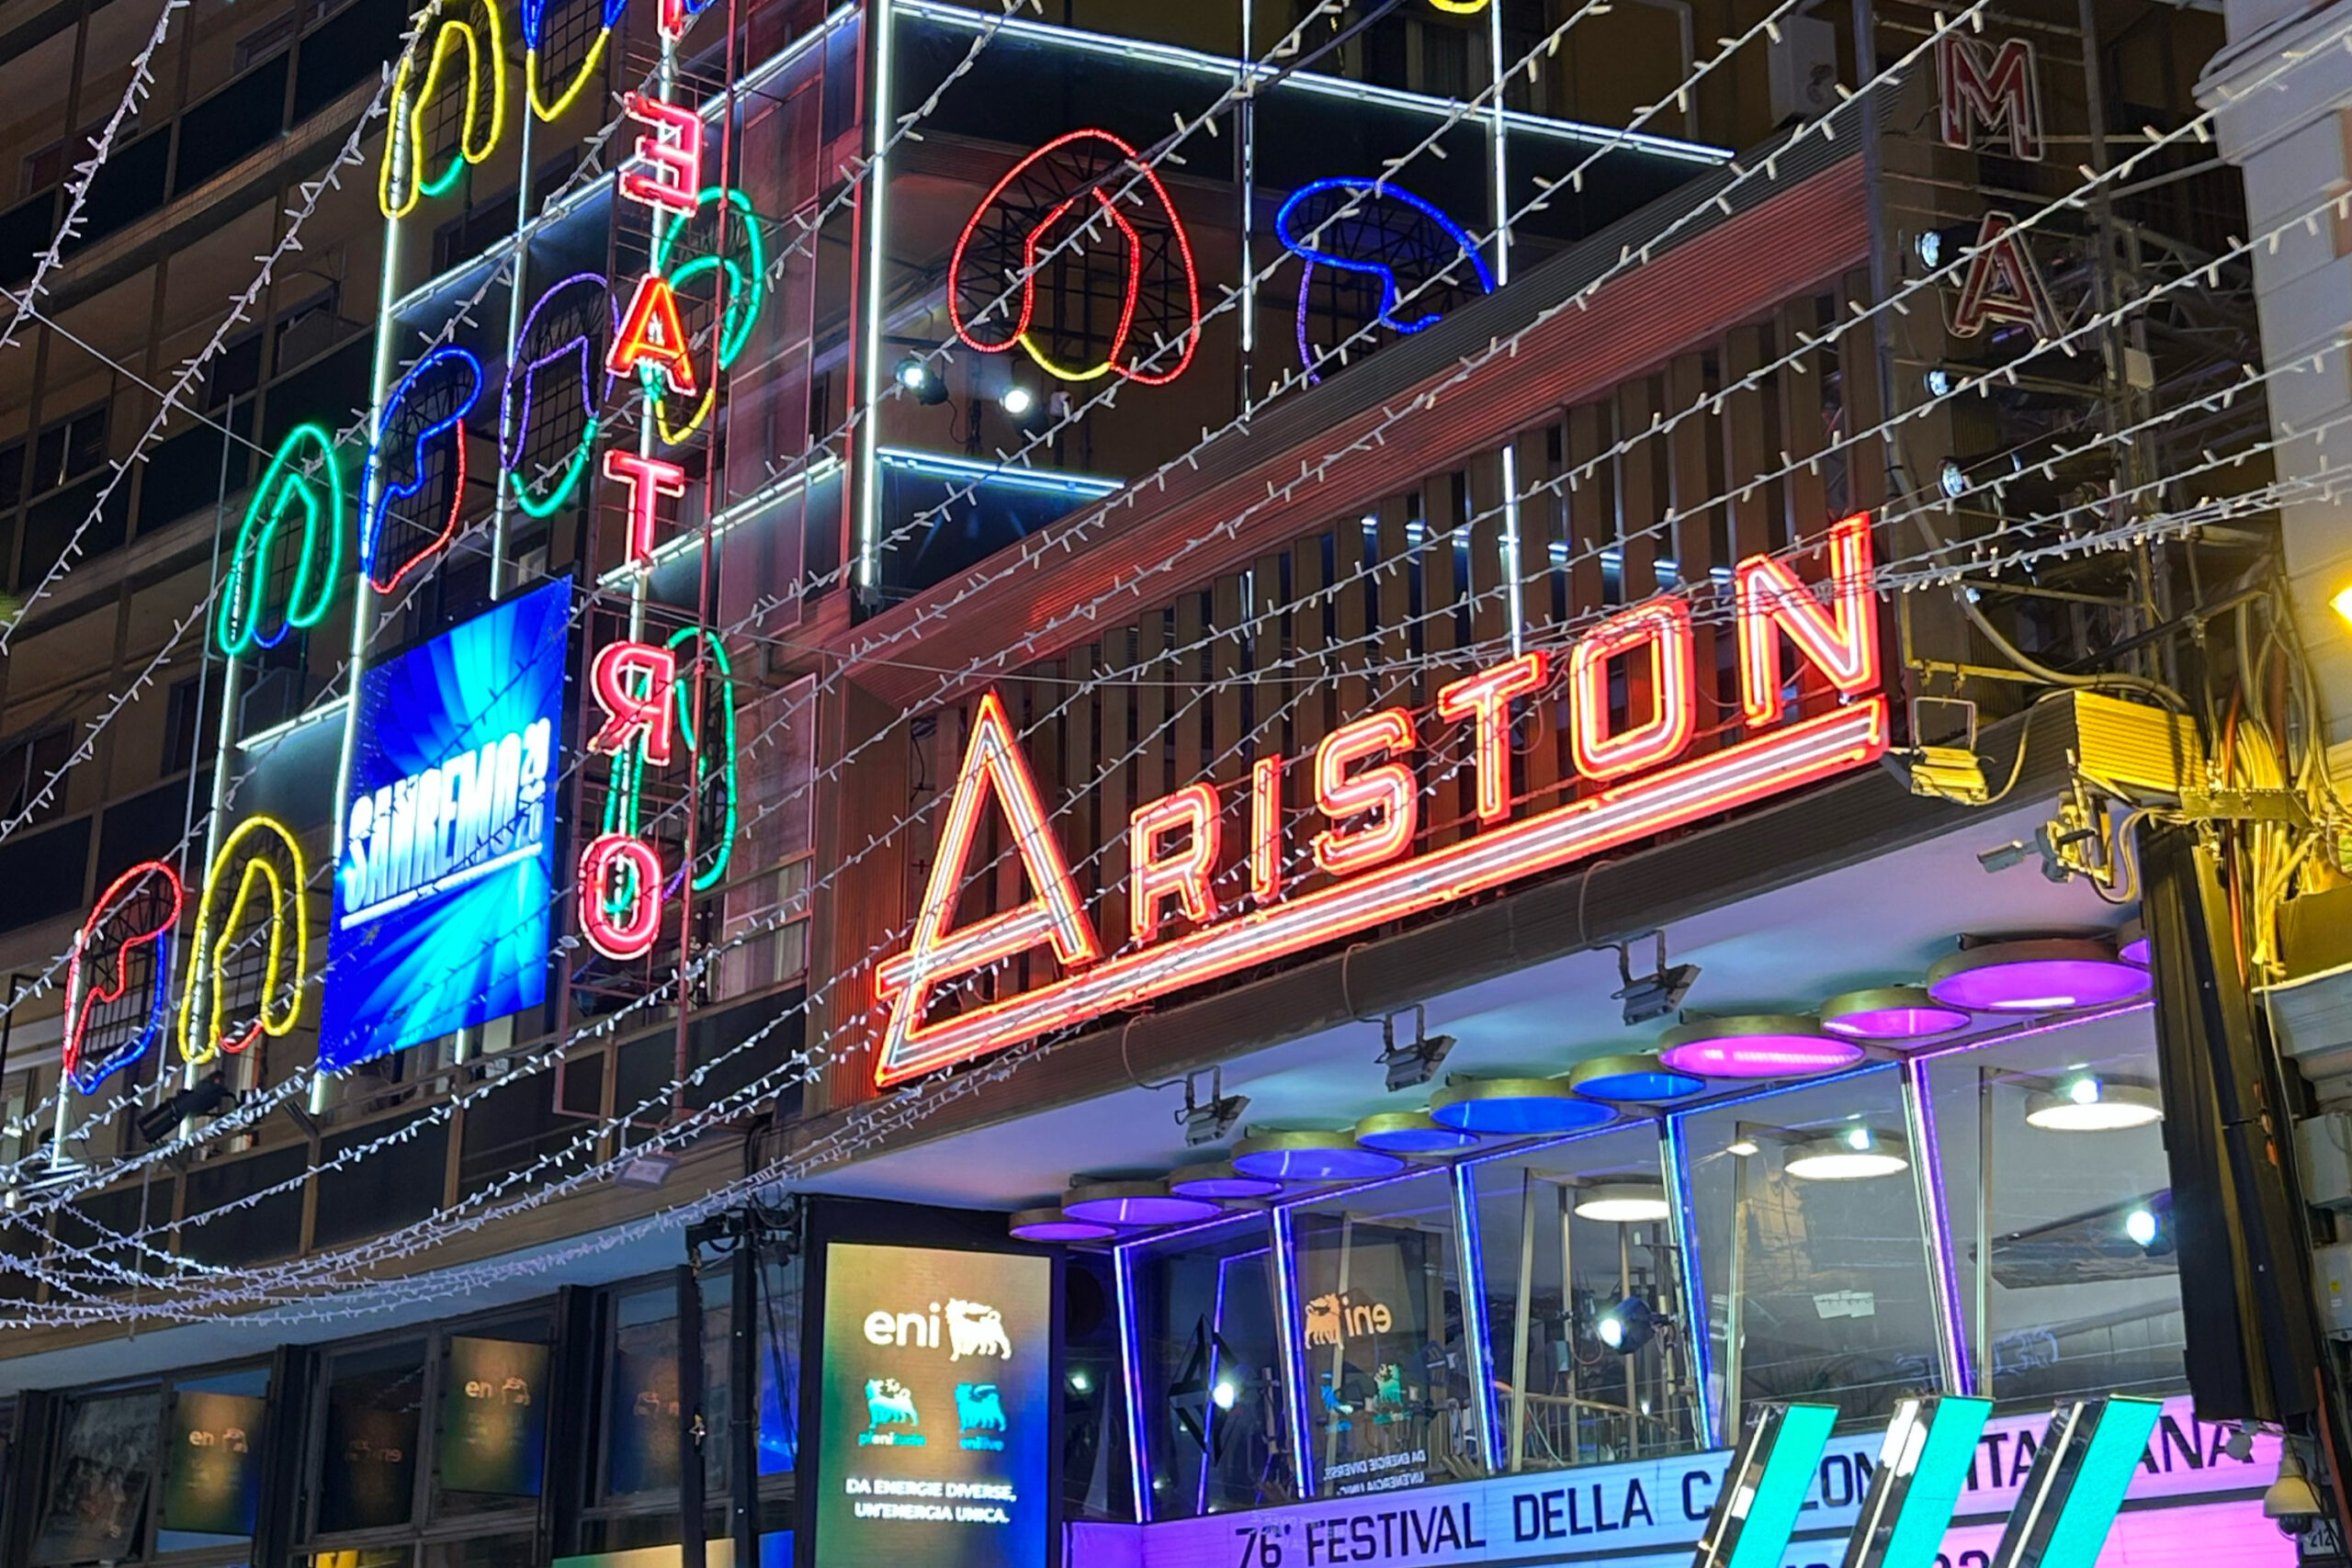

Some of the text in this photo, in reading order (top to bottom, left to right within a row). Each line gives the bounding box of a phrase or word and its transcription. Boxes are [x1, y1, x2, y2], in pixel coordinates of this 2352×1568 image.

[343, 732, 522, 913] SANREMO
[872, 511, 1876, 1089] ARISTON
[864, 1302, 941, 1348] eni
[845, 1478, 871, 1495] DA
[874, 1480, 943, 1497] ENERGIE
[1306, 1502, 1487, 1567] FESTIVAL
[1512, 1477, 1654, 1543] DELLA
